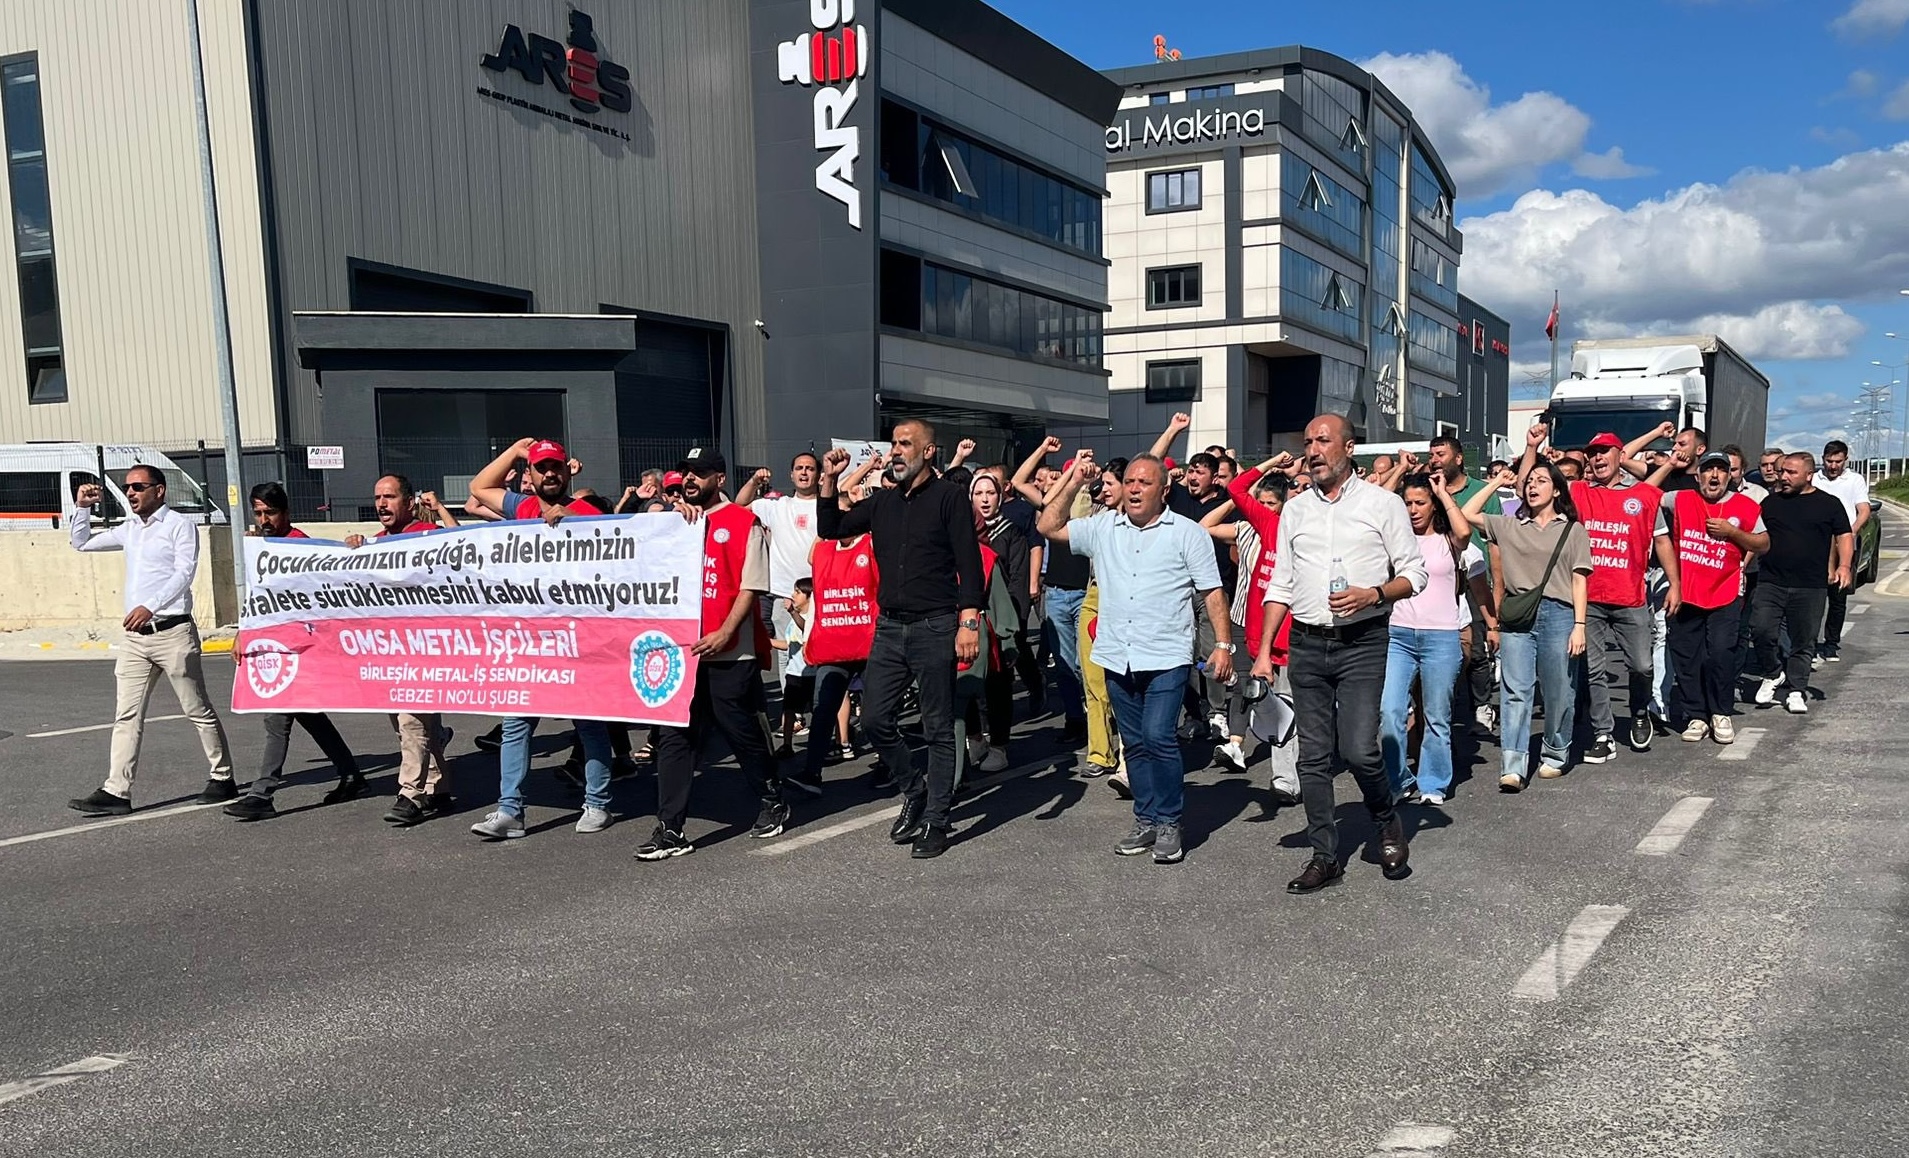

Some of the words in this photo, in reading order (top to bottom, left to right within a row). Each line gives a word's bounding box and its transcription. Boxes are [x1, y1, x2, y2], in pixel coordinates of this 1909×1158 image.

[480, 22, 632, 114] ARES
[1105, 119, 1130, 149] al
[1143, 108, 1264, 145] Makina
[1584, 518, 1631, 535] BİRLEŞİK
[256, 550, 407, 583] Çocuklarımızın
[412, 537, 484, 575] açlığa,
[490, 527, 636, 564] ailelerimizin
[1589, 537, 1628, 553] ETAL-İŞ
[1679, 539, 1709, 553] METAL
[1715, 547, 1727, 559] İŞ
[1590, 553, 1629, 568] NDİKASI
[1679, 551, 1724, 569] ENDİKASI
[314, 575, 480, 609] sürüklenmesini
[477, 578, 546, 605] kabul
[547, 573, 680, 613] etmiyoruz!
[823, 585, 866, 599] BİRLEŞİK
[822, 602, 851, 613] METAL
[858, 600, 870, 612] İŞ
[821, 613, 872, 627] SENDİKASI
[338, 628, 406, 656] OMSA
[405, 628, 482, 656] METAL
[480, 620, 580, 665] İŞÇİLERİ
[359, 661, 418, 685] BİRLEŞİK
[421, 663, 487, 686] METAL-İŞ
[488, 664, 576, 685] SENDİKASI
[389, 688, 434, 704] GEBZE
[437, 688, 443, 704] 1
[488, 689, 531, 709] ŞUBE
